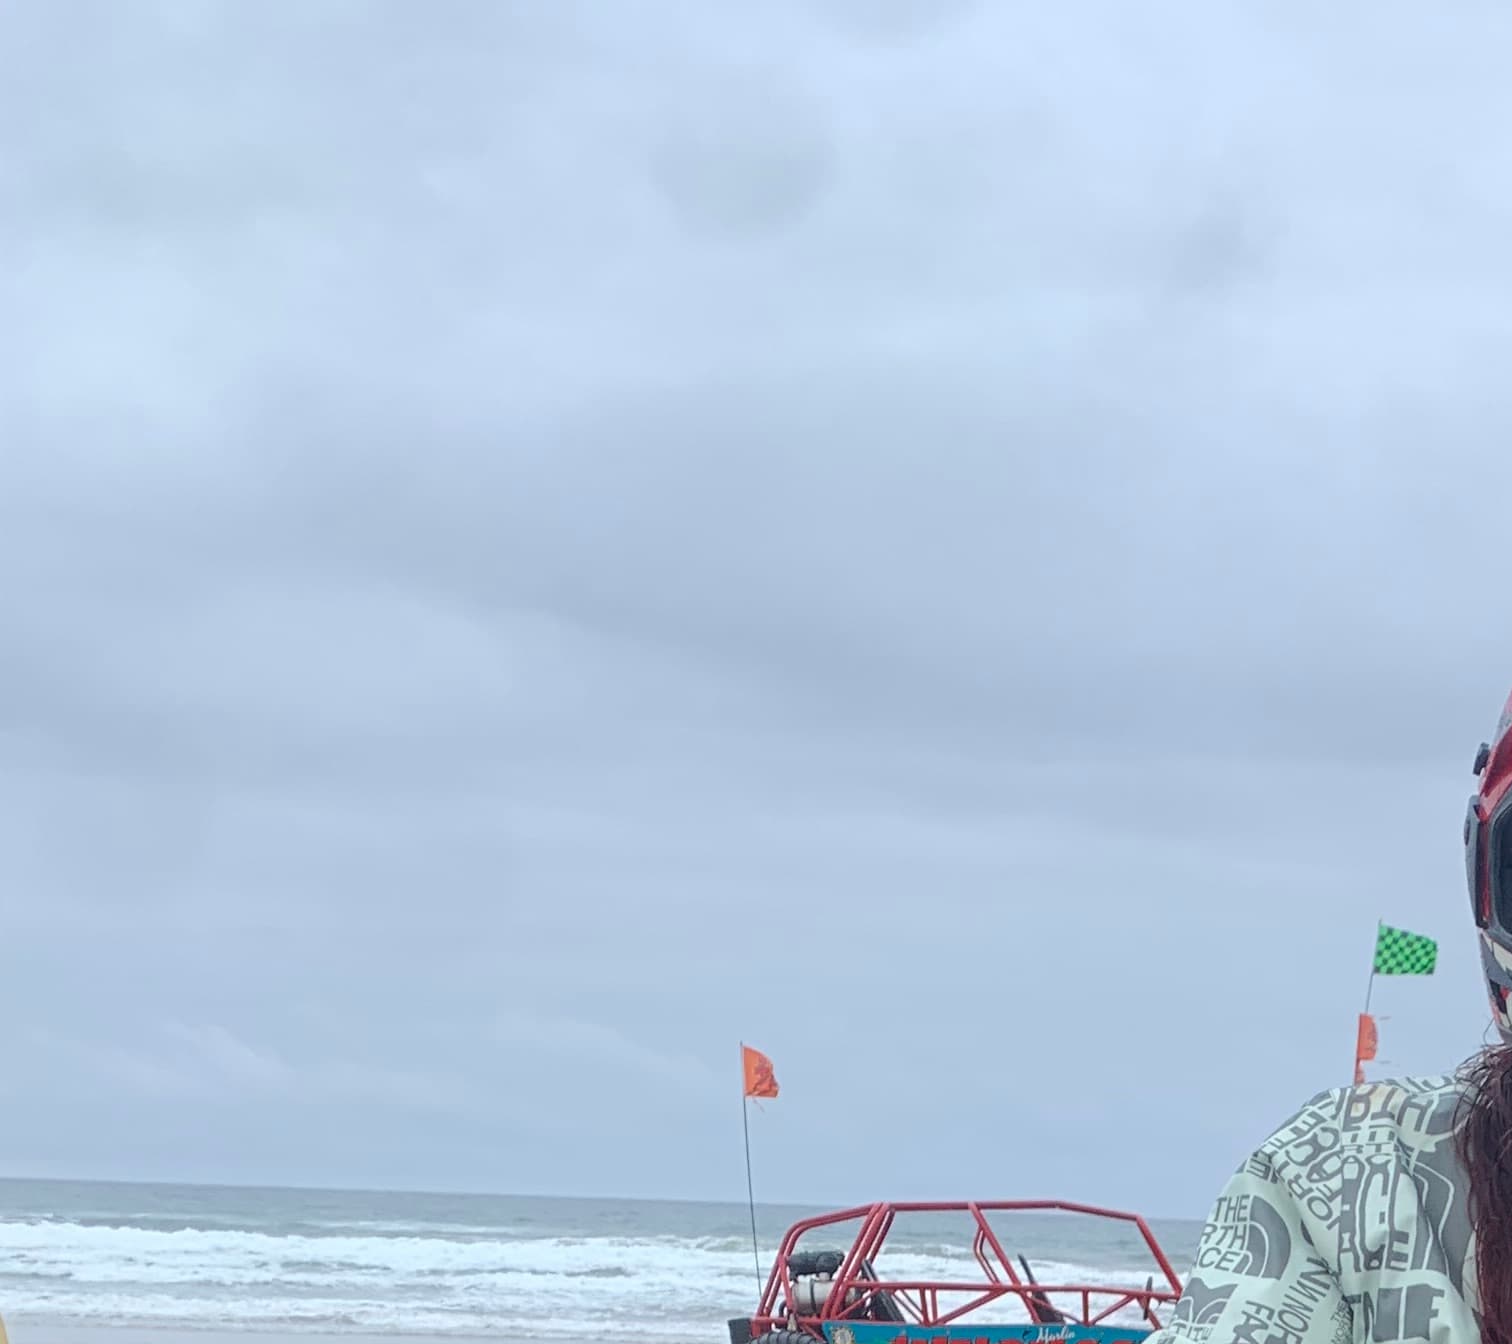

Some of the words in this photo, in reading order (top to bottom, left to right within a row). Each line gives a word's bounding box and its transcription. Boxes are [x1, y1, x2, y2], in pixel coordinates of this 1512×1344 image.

[1213, 1194, 1250, 1223] THE
[1200, 1223, 1248, 1251] RTH
[1196, 1246, 1238, 1272] CE
[1036, 1326, 1076, 1344] Marlin
